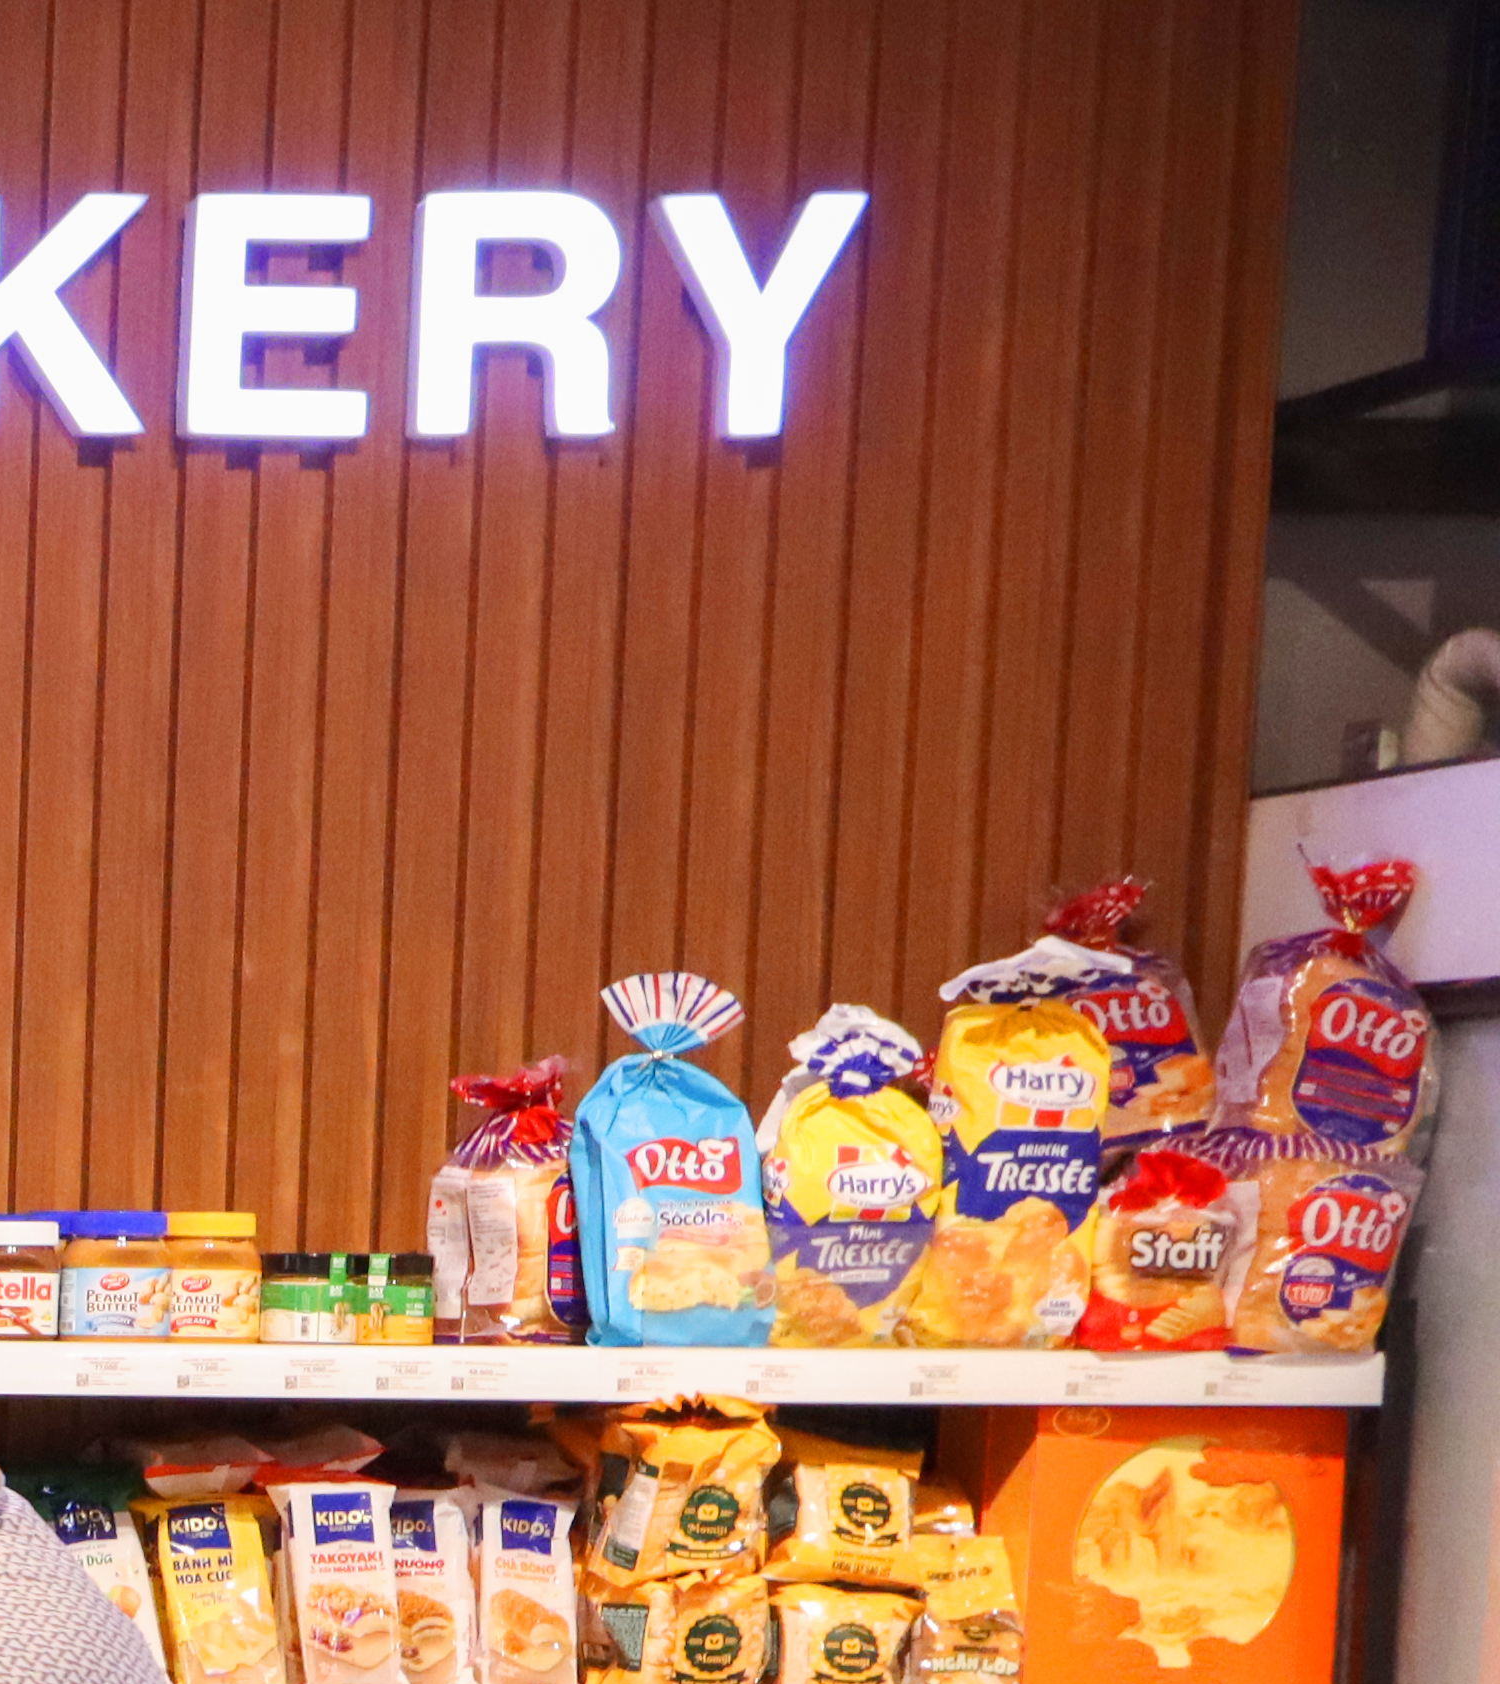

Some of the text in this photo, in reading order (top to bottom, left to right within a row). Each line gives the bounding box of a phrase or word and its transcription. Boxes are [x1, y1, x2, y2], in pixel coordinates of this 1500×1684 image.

[1319, 997, 1419, 1058] Otto
[1018, 1143, 1068, 1159] BRIOCHE
[633, 1140, 727, 1183] Otto
[977, 1152, 1097, 1195] TRESSÉE
[839, 1173, 918, 1196] Harry's
[1302, 1198, 1393, 1251] Otto
[1131, 1230, 1224, 1270] Staff
[86, 1290, 139, 1305] PEANUT
[86, 1301, 138, 1314] BUTTER
[315, 1509, 373, 1527] KIDO's
[173, 1553, 209, 1572] BÁNH
[309, 1551, 383, 1565] TAKOYAKI
[175, 1568, 204, 1585] HOA
